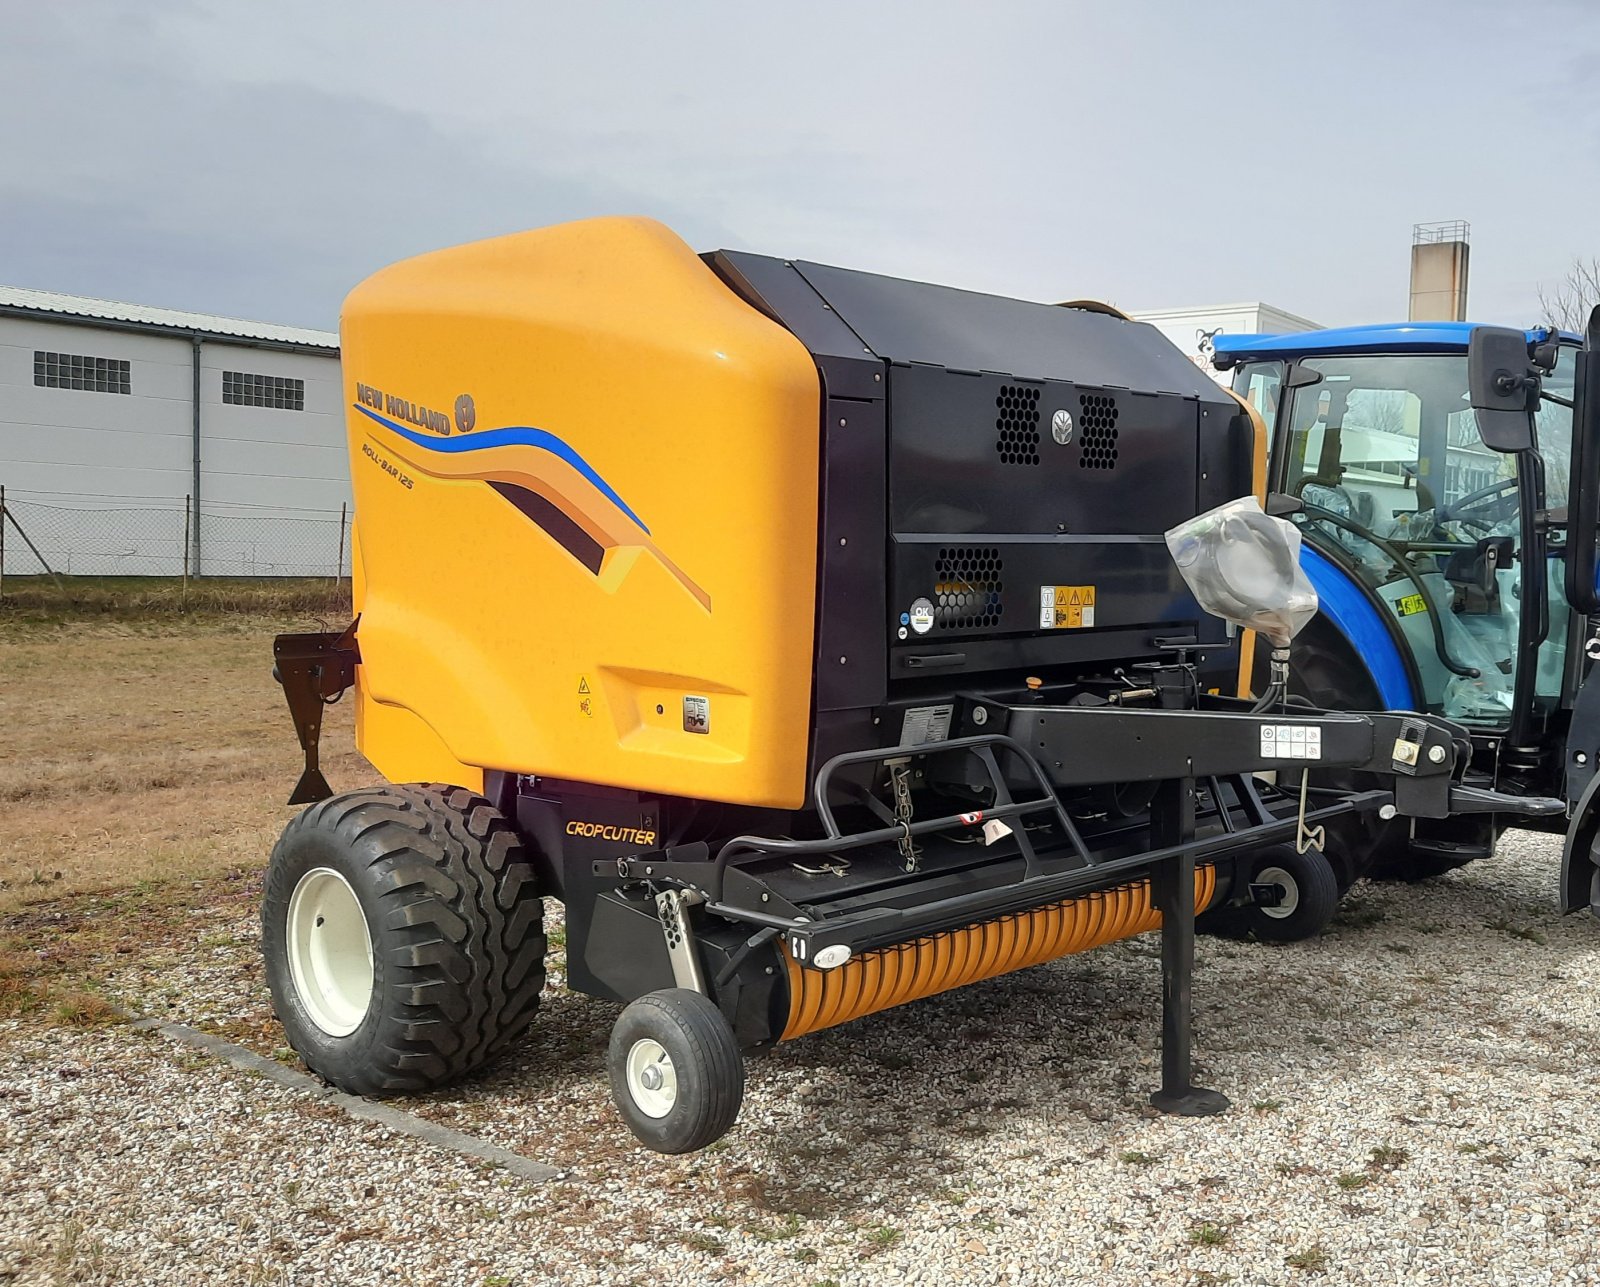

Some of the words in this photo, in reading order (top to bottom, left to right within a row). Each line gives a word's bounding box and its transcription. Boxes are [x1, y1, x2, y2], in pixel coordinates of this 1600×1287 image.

[357, 382, 382, 411] NEW
[386, 394, 450, 436] HOLLAND
[362, 443, 398, 478] ROLL-BAR
[399, 473, 415, 490] 125
[915, 607, 928, 616] OK
[565, 821, 656, 846] CROPCUTTER
